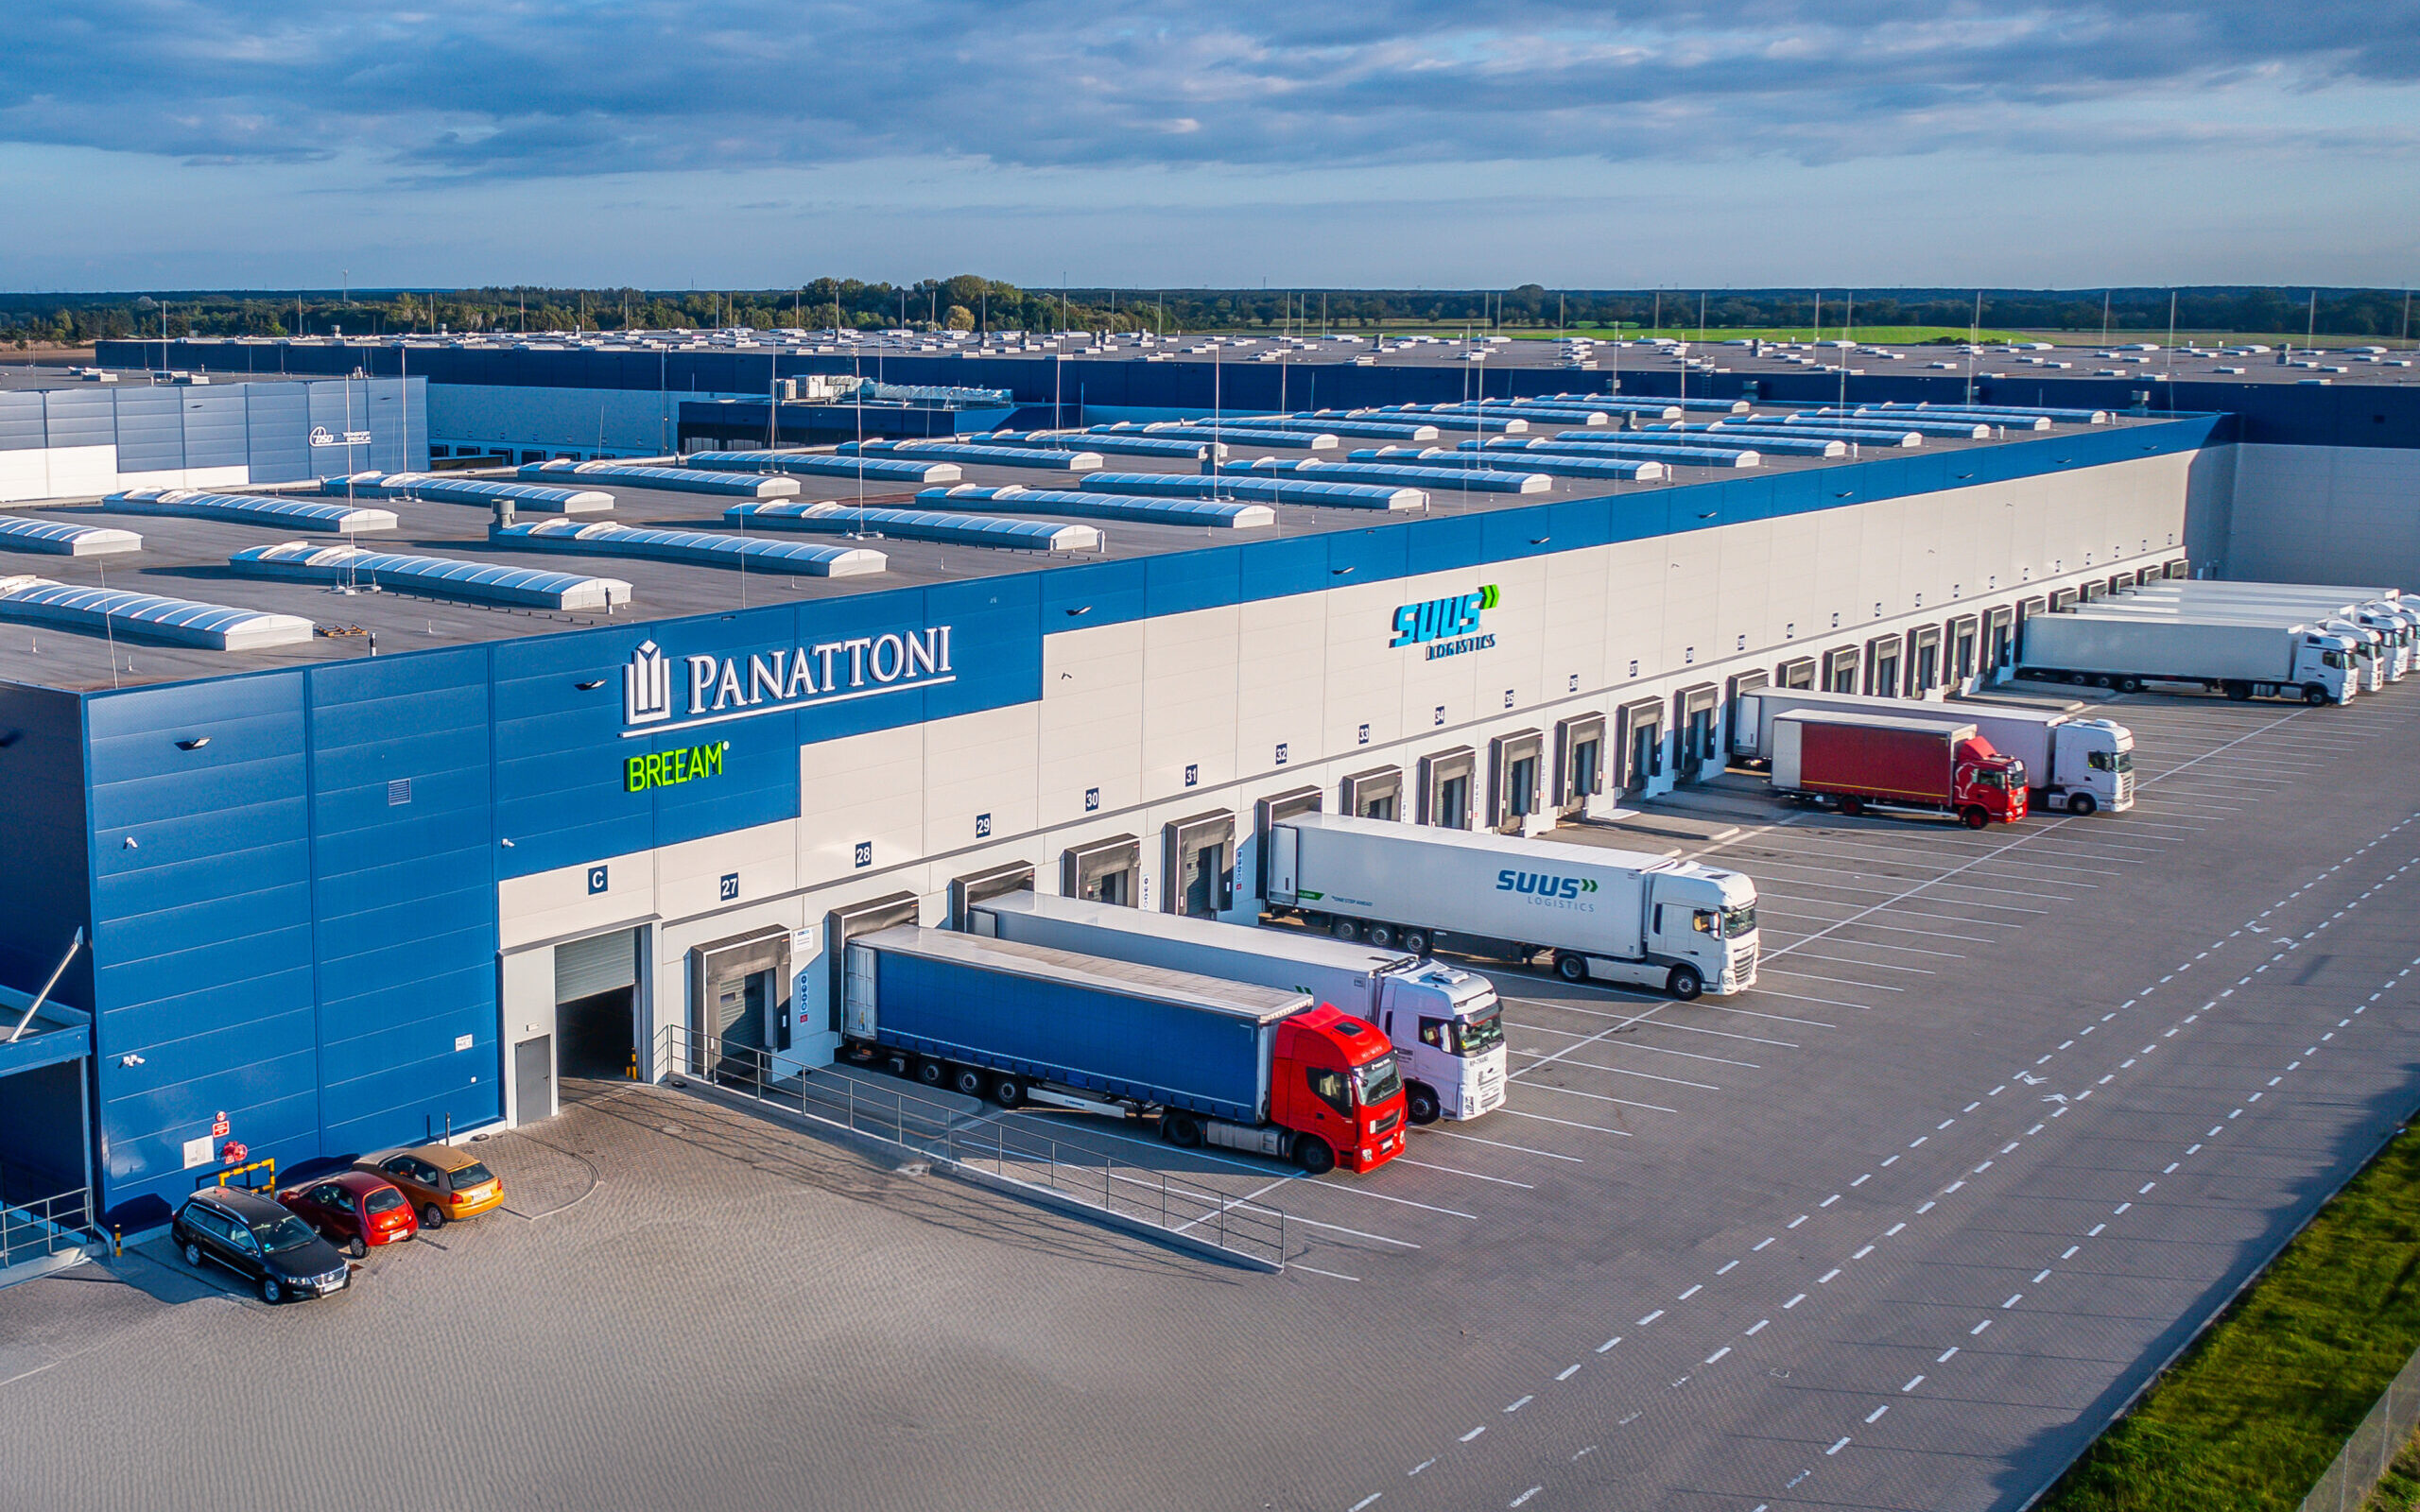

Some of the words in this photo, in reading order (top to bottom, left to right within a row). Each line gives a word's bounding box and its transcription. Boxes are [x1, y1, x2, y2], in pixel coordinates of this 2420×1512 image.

[1389, 592, 1483, 648] SUUS
[1426, 633, 1496, 661] LOGISTICS
[685, 626, 953, 714] PANATTONI
[1435, 709, 1444, 722] 34
[1359, 728, 1369, 741] 33
[1276, 747, 1287, 761] 32
[624, 742, 722, 792] BREEAM
[1186, 768, 1197, 783] 31
[1086, 792, 1098, 808] 30
[977, 817, 991, 834] 29
[856, 846, 871, 864] 28
[592, 870, 604, 889] C
[721, 877, 738, 897] 27
[1495, 869, 1580, 900] SUUS
[1528, 896, 1595, 913] LOGISTICS
